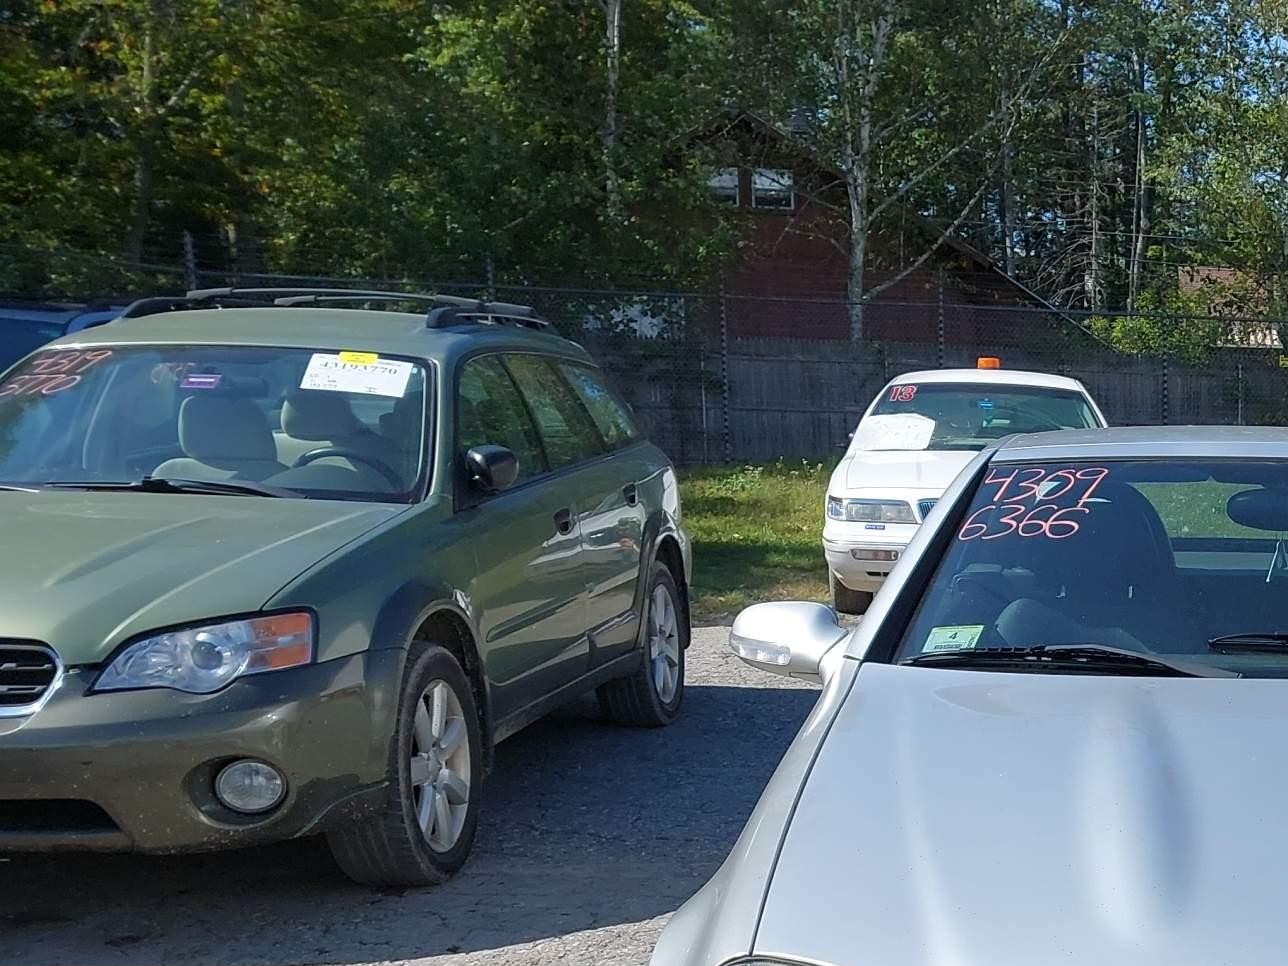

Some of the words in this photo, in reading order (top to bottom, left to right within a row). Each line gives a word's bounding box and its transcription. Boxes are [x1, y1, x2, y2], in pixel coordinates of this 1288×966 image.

[889, 385, 918, 402] 13
[984, 467, 1109, 508] 4309
[957, 504, 1090, 541] 6366
[948, 631, 958, 640] 4
